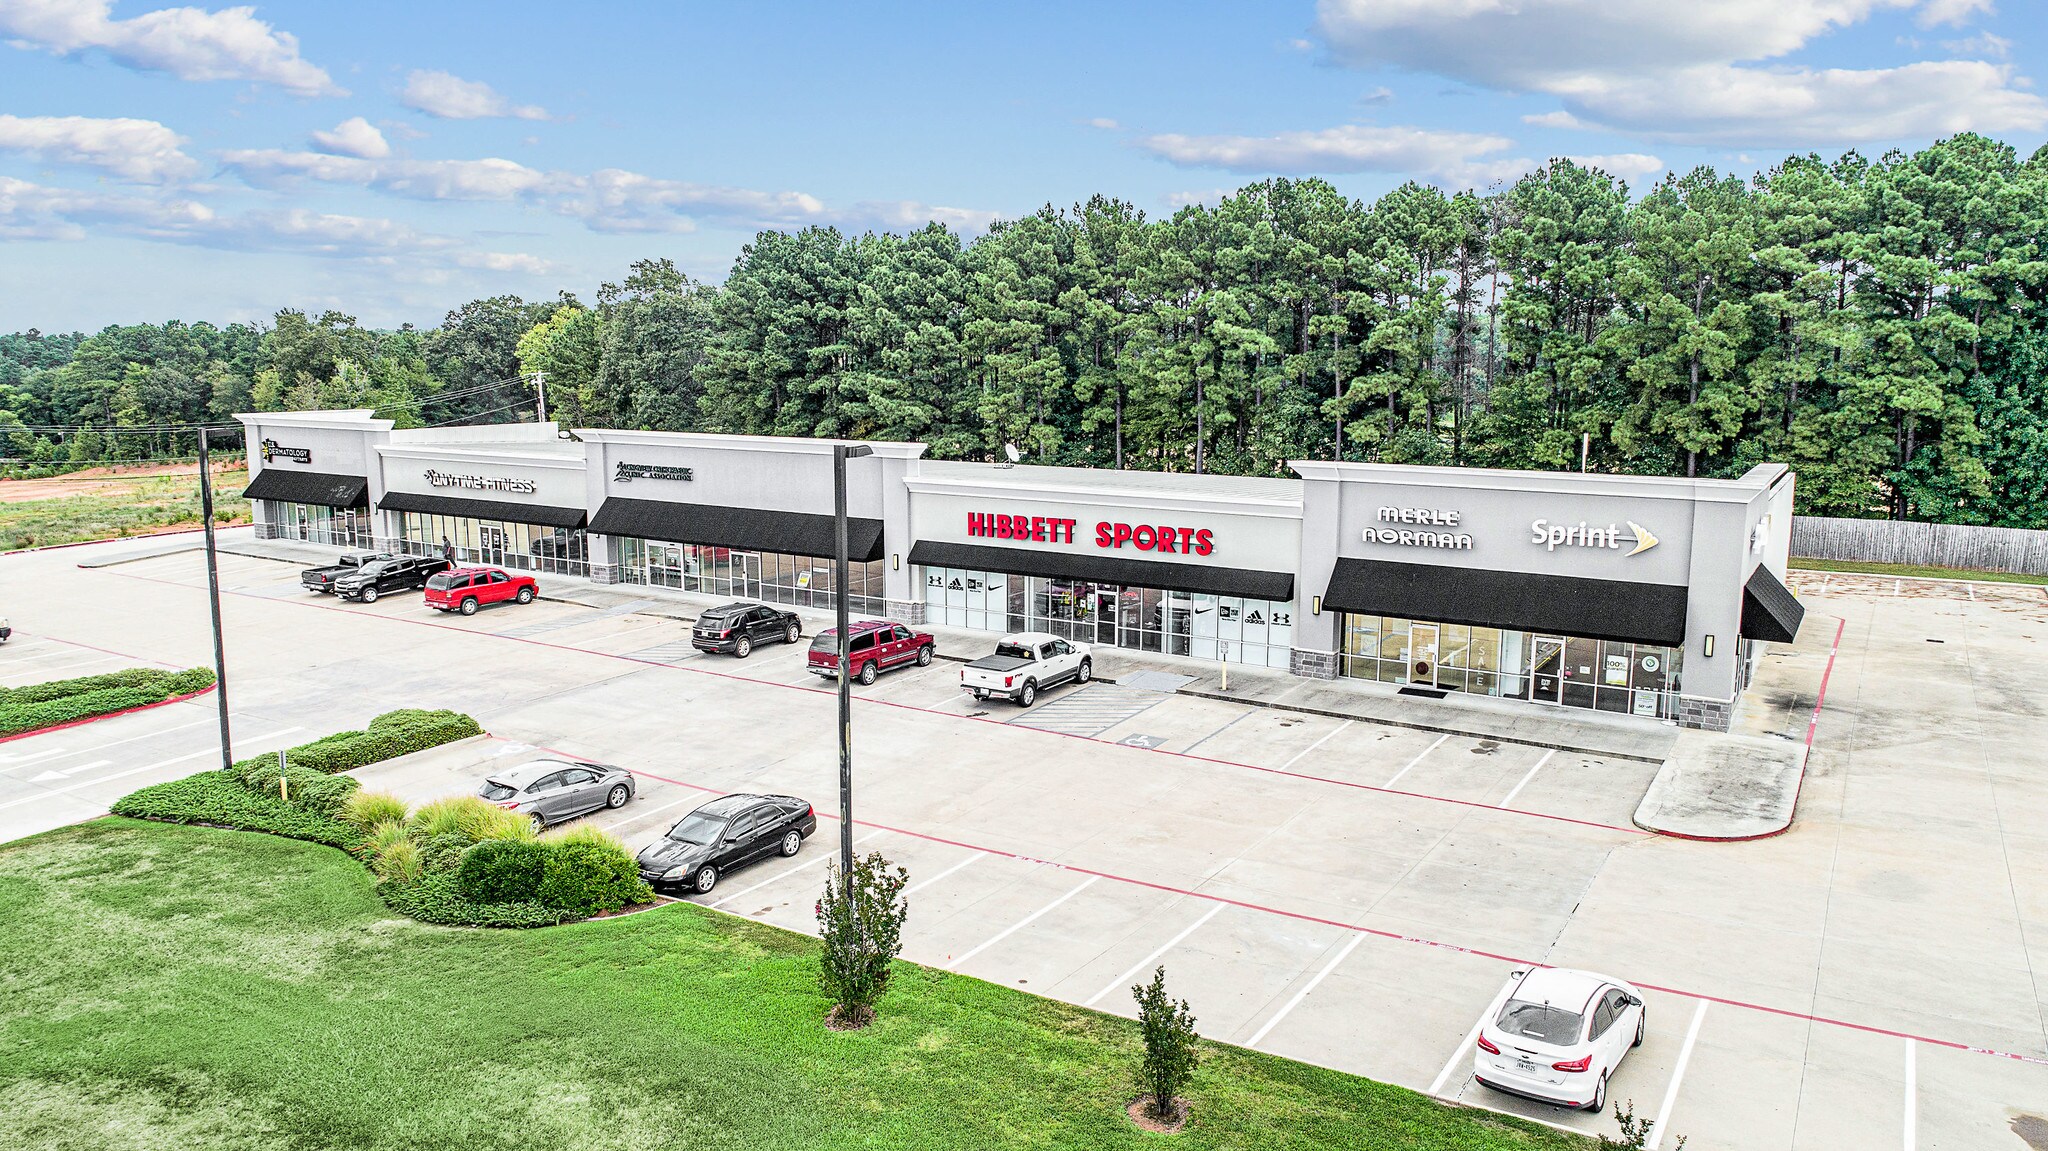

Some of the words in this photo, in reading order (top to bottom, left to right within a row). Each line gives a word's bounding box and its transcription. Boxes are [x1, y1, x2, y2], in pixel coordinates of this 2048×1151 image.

[268, 448, 308, 457] DERMATOLOGY
[432, 472, 482, 489] ANYTIME
[484, 477, 534, 494] FITNESS
[649, 473, 693, 481] ASSOCIATION
[1377, 506, 1460, 527] MERLE
[967, 512, 1076, 544] HIBBETT
[1095, 521, 1214, 556] SPORTS
[1362, 527, 1473, 550] NORMAN
[1531, 518, 1620, 552] Sprint
